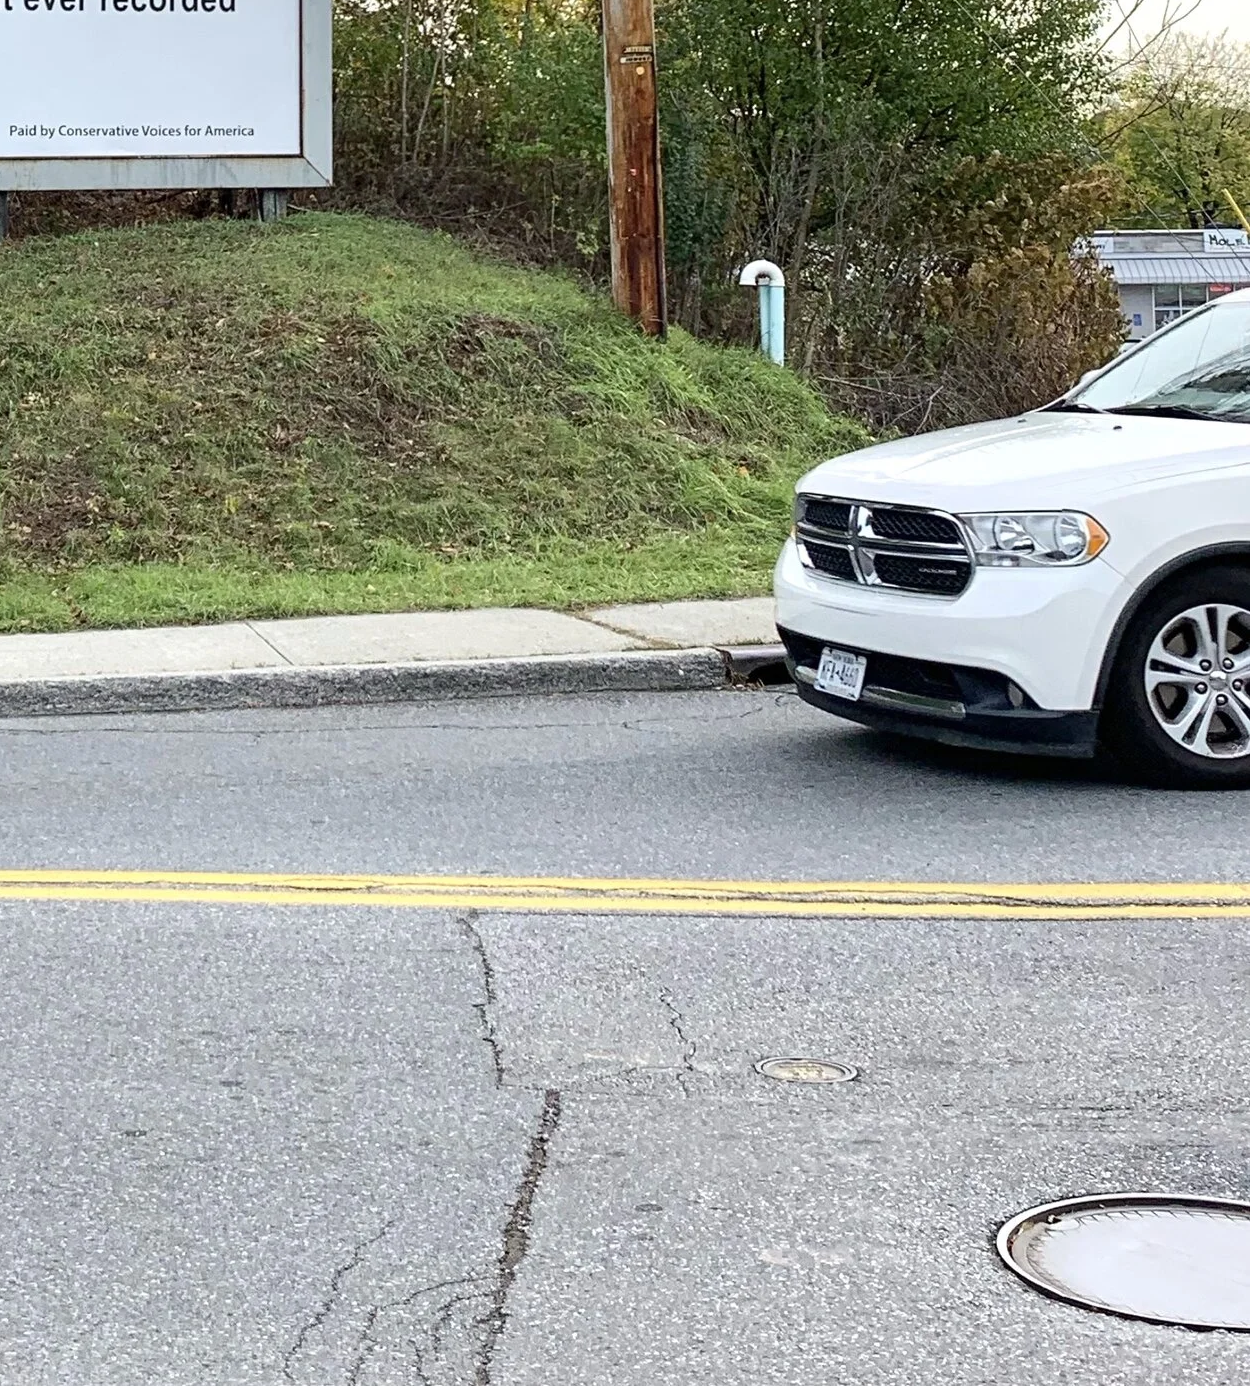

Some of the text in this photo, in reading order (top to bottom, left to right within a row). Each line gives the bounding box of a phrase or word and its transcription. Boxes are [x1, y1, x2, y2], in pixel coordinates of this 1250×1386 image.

[9, 124, 255, 140] Paid by Conservative Voices for America
